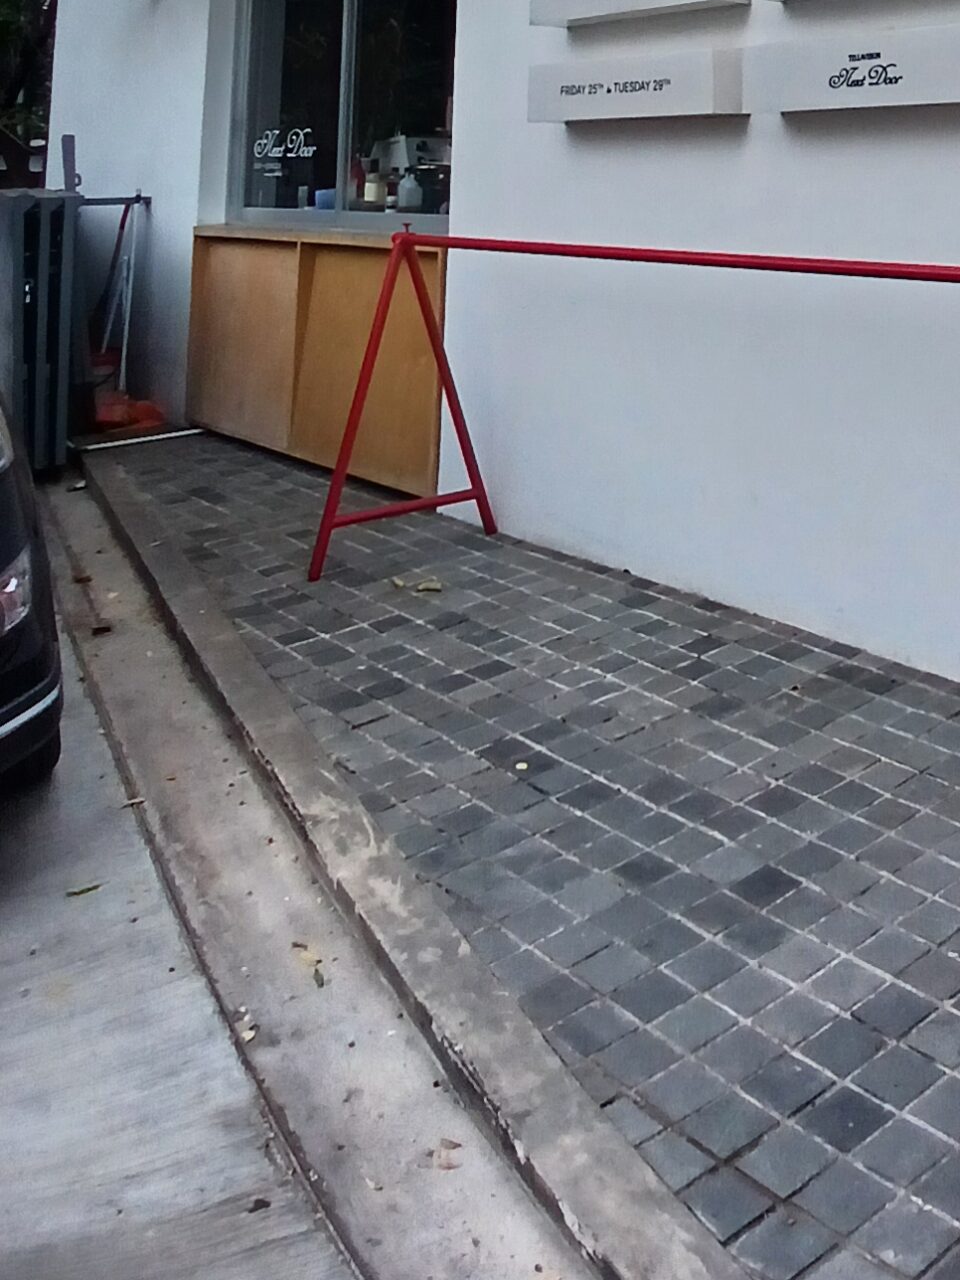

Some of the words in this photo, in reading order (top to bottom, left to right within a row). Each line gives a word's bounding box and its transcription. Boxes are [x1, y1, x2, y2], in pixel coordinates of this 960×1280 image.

[560, 84, 587, 96] FRIDAY
[614, 80, 651, 94] TUESDAY
[828, 66, 866, 89] Next
[868, 63, 903, 86] Door
[254, 130, 286, 158] Next
[286, 127, 317, 157] Door
